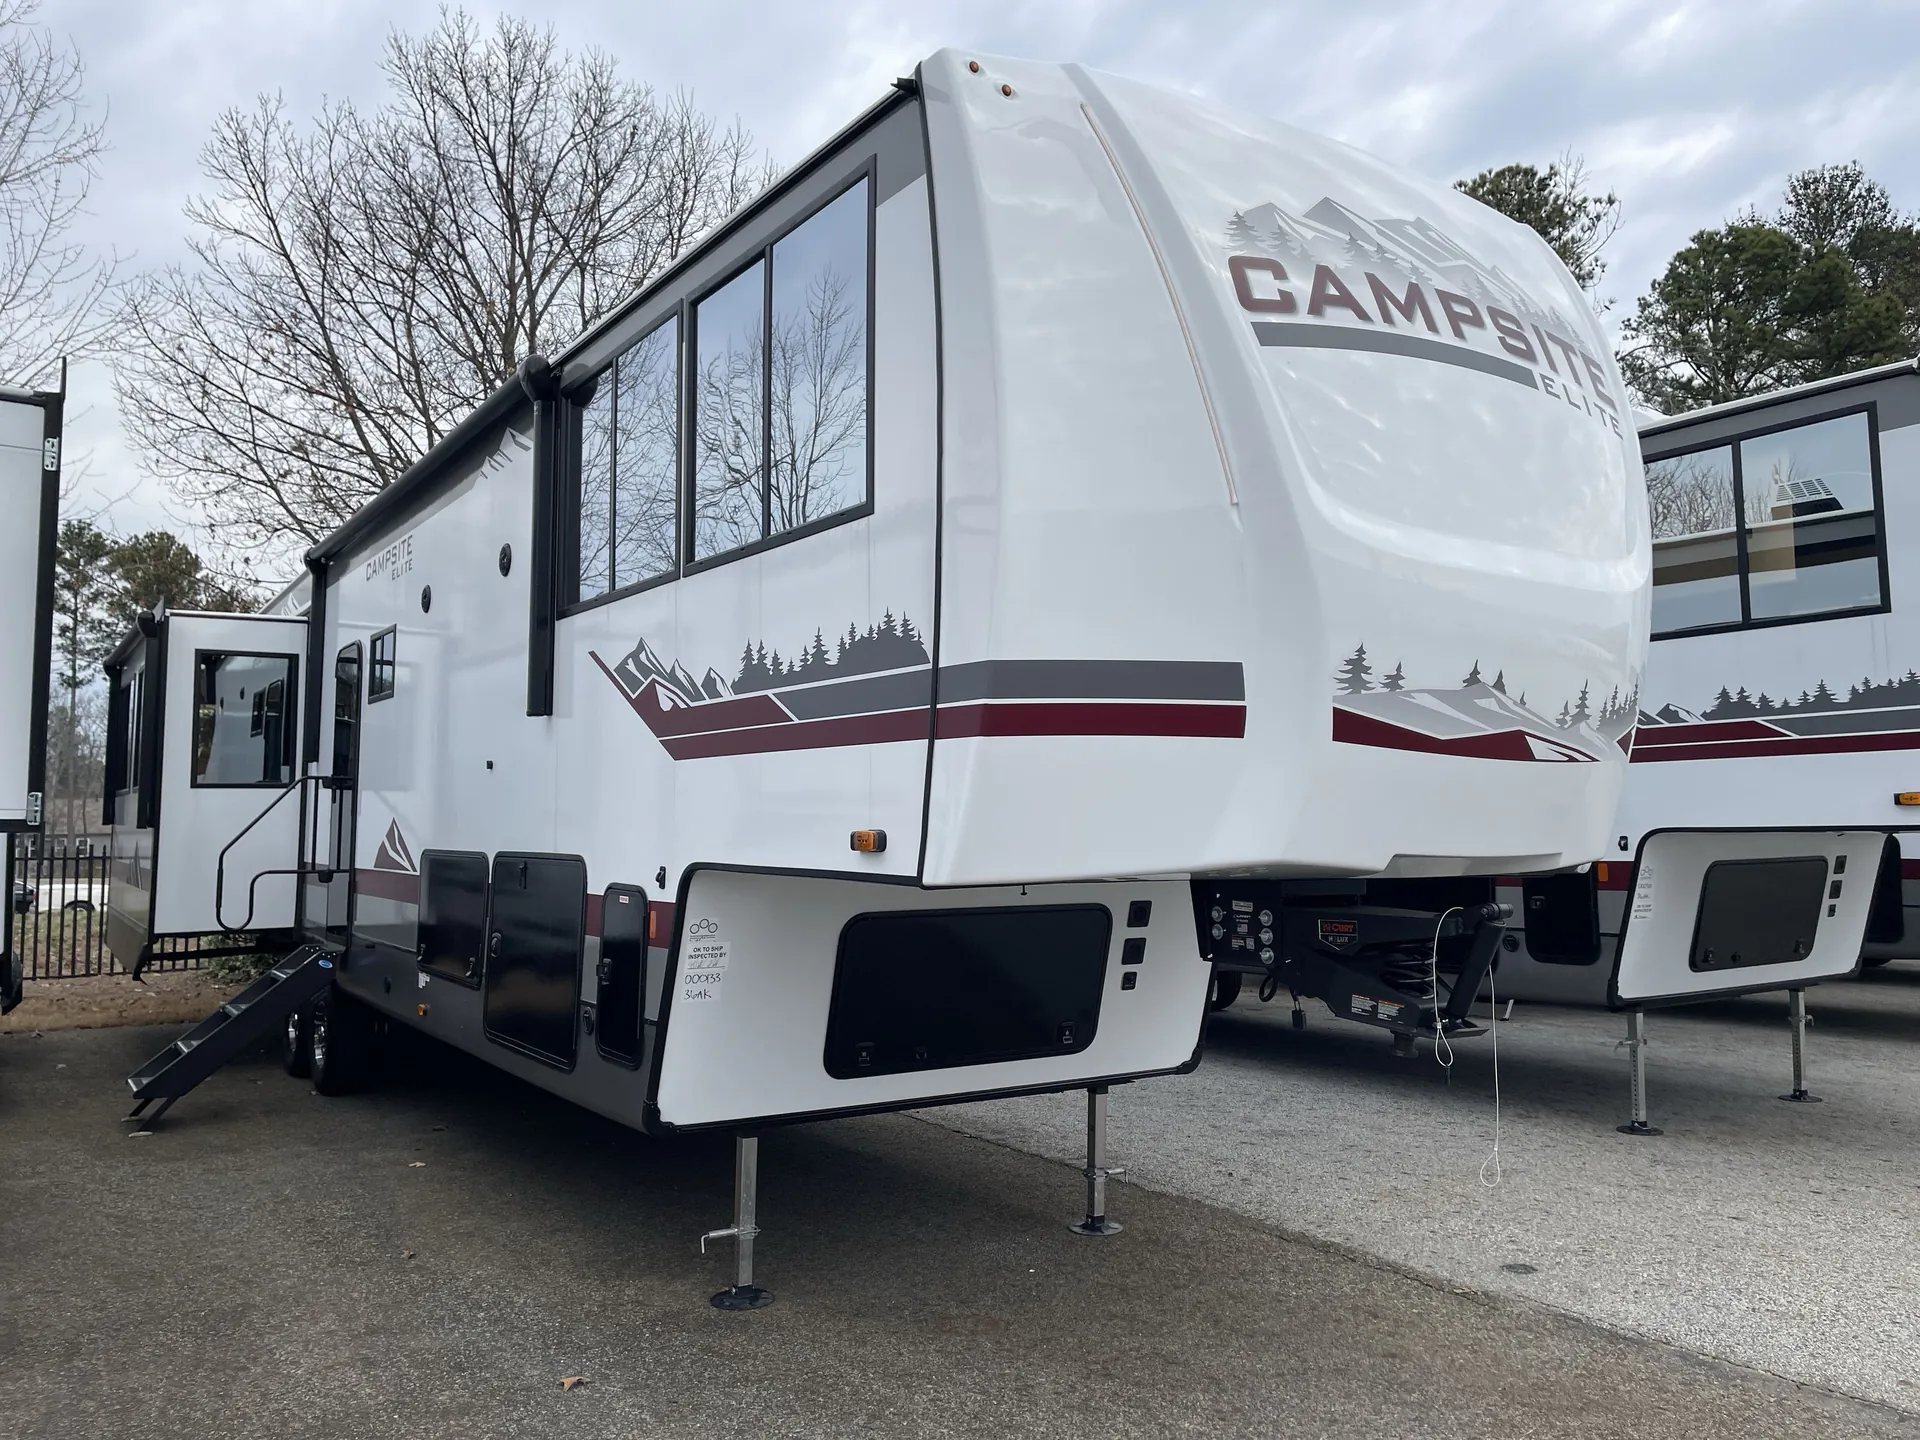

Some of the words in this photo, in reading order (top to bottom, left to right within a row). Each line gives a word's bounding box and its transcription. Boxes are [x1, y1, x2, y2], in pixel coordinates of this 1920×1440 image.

[1228, 255, 1617, 412] CAMPSITE
[1539, 372, 1624, 440] ELITE
[366, 534, 413, 582] CAMPSITE
[391, 558, 413, 581] ELITE
[688, 952, 718, 960] INSPECTED
